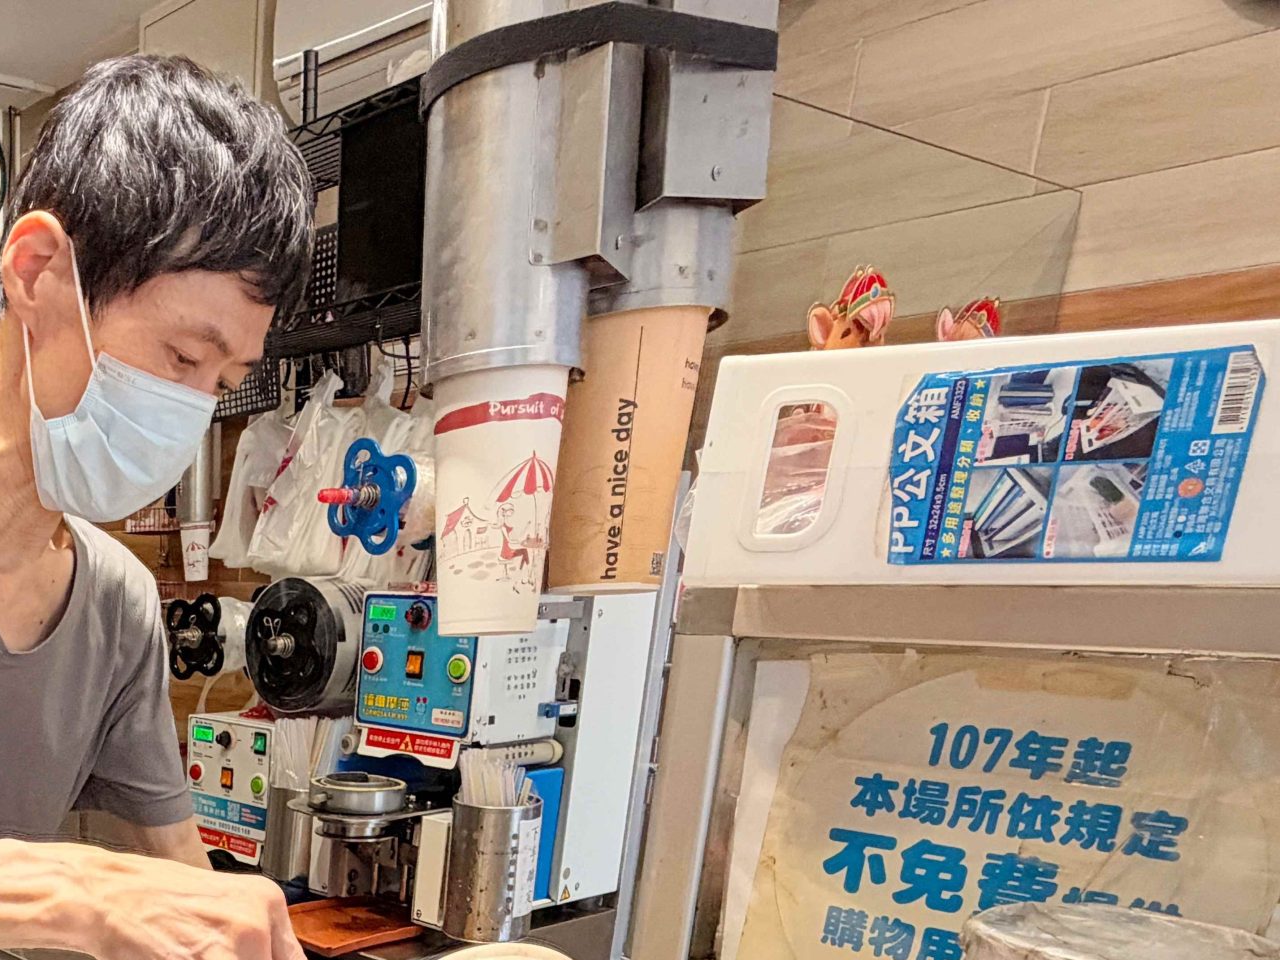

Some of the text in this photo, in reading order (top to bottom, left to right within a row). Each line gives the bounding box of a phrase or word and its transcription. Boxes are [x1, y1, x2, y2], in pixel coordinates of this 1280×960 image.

[488, 401, 545, 416] Pursuit
[950, 379, 966, 420] AMF3323
[600, 398, 638, 580] have a nice day
[890, 387, 949, 554] PP公文箱
[928, 722, 1132, 788] 107年起
[850, 773, 1189, 862] 本場所依規定
[822, 827, 1183, 918] 不免費
